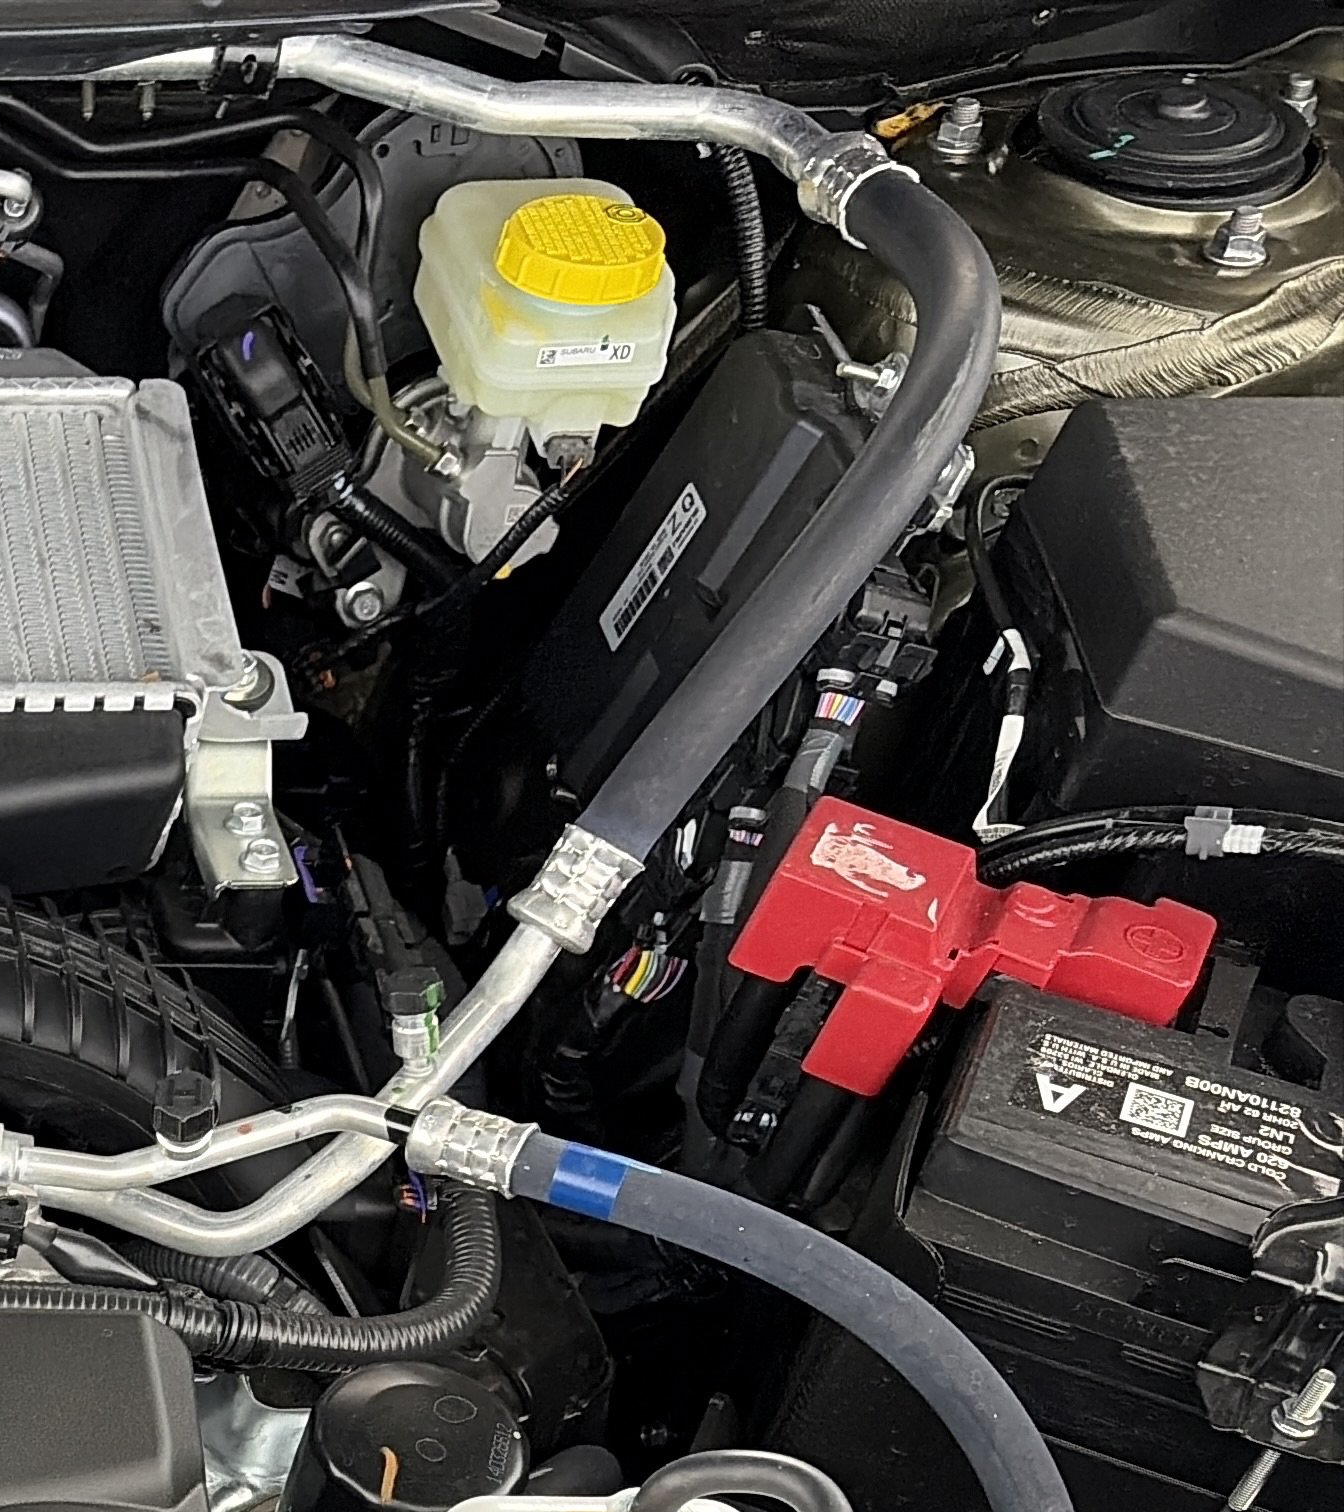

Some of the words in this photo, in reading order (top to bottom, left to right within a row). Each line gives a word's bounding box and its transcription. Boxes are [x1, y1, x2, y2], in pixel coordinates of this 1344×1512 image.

[561, 347, 597, 356] SUBARU
[608, 344, 632, 361] XD
[1045, 1033, 1099, 1054] MATERIALS
[1061, 1045, 1086, 1057] WITH
[1100, 1050, 1150, 1069] IMPORTED
[1132, 1066, 1160, 1079] MADE
[1152, 1065, 1173, 1076] AND
[1184, 1075, 1302, 1118] 82110AN00B
[1262, 1112, 1299, 1129] 20HR
[1130, 1126, 1171, 1145] AMPS
[1209, 1124, 1241, 1140] SIZE
[1258, 1125, 1296, 1144] LN2
[1172, 1139, 1246, 1168] CRANKING
[1196, 1133, 1253, 1159] AMPS
[1242, 1134, 1293, 1155] GROUP
[1256, 1151, 1290, 1170] 620
[1247, 1162, 1287, 1180] COLD
